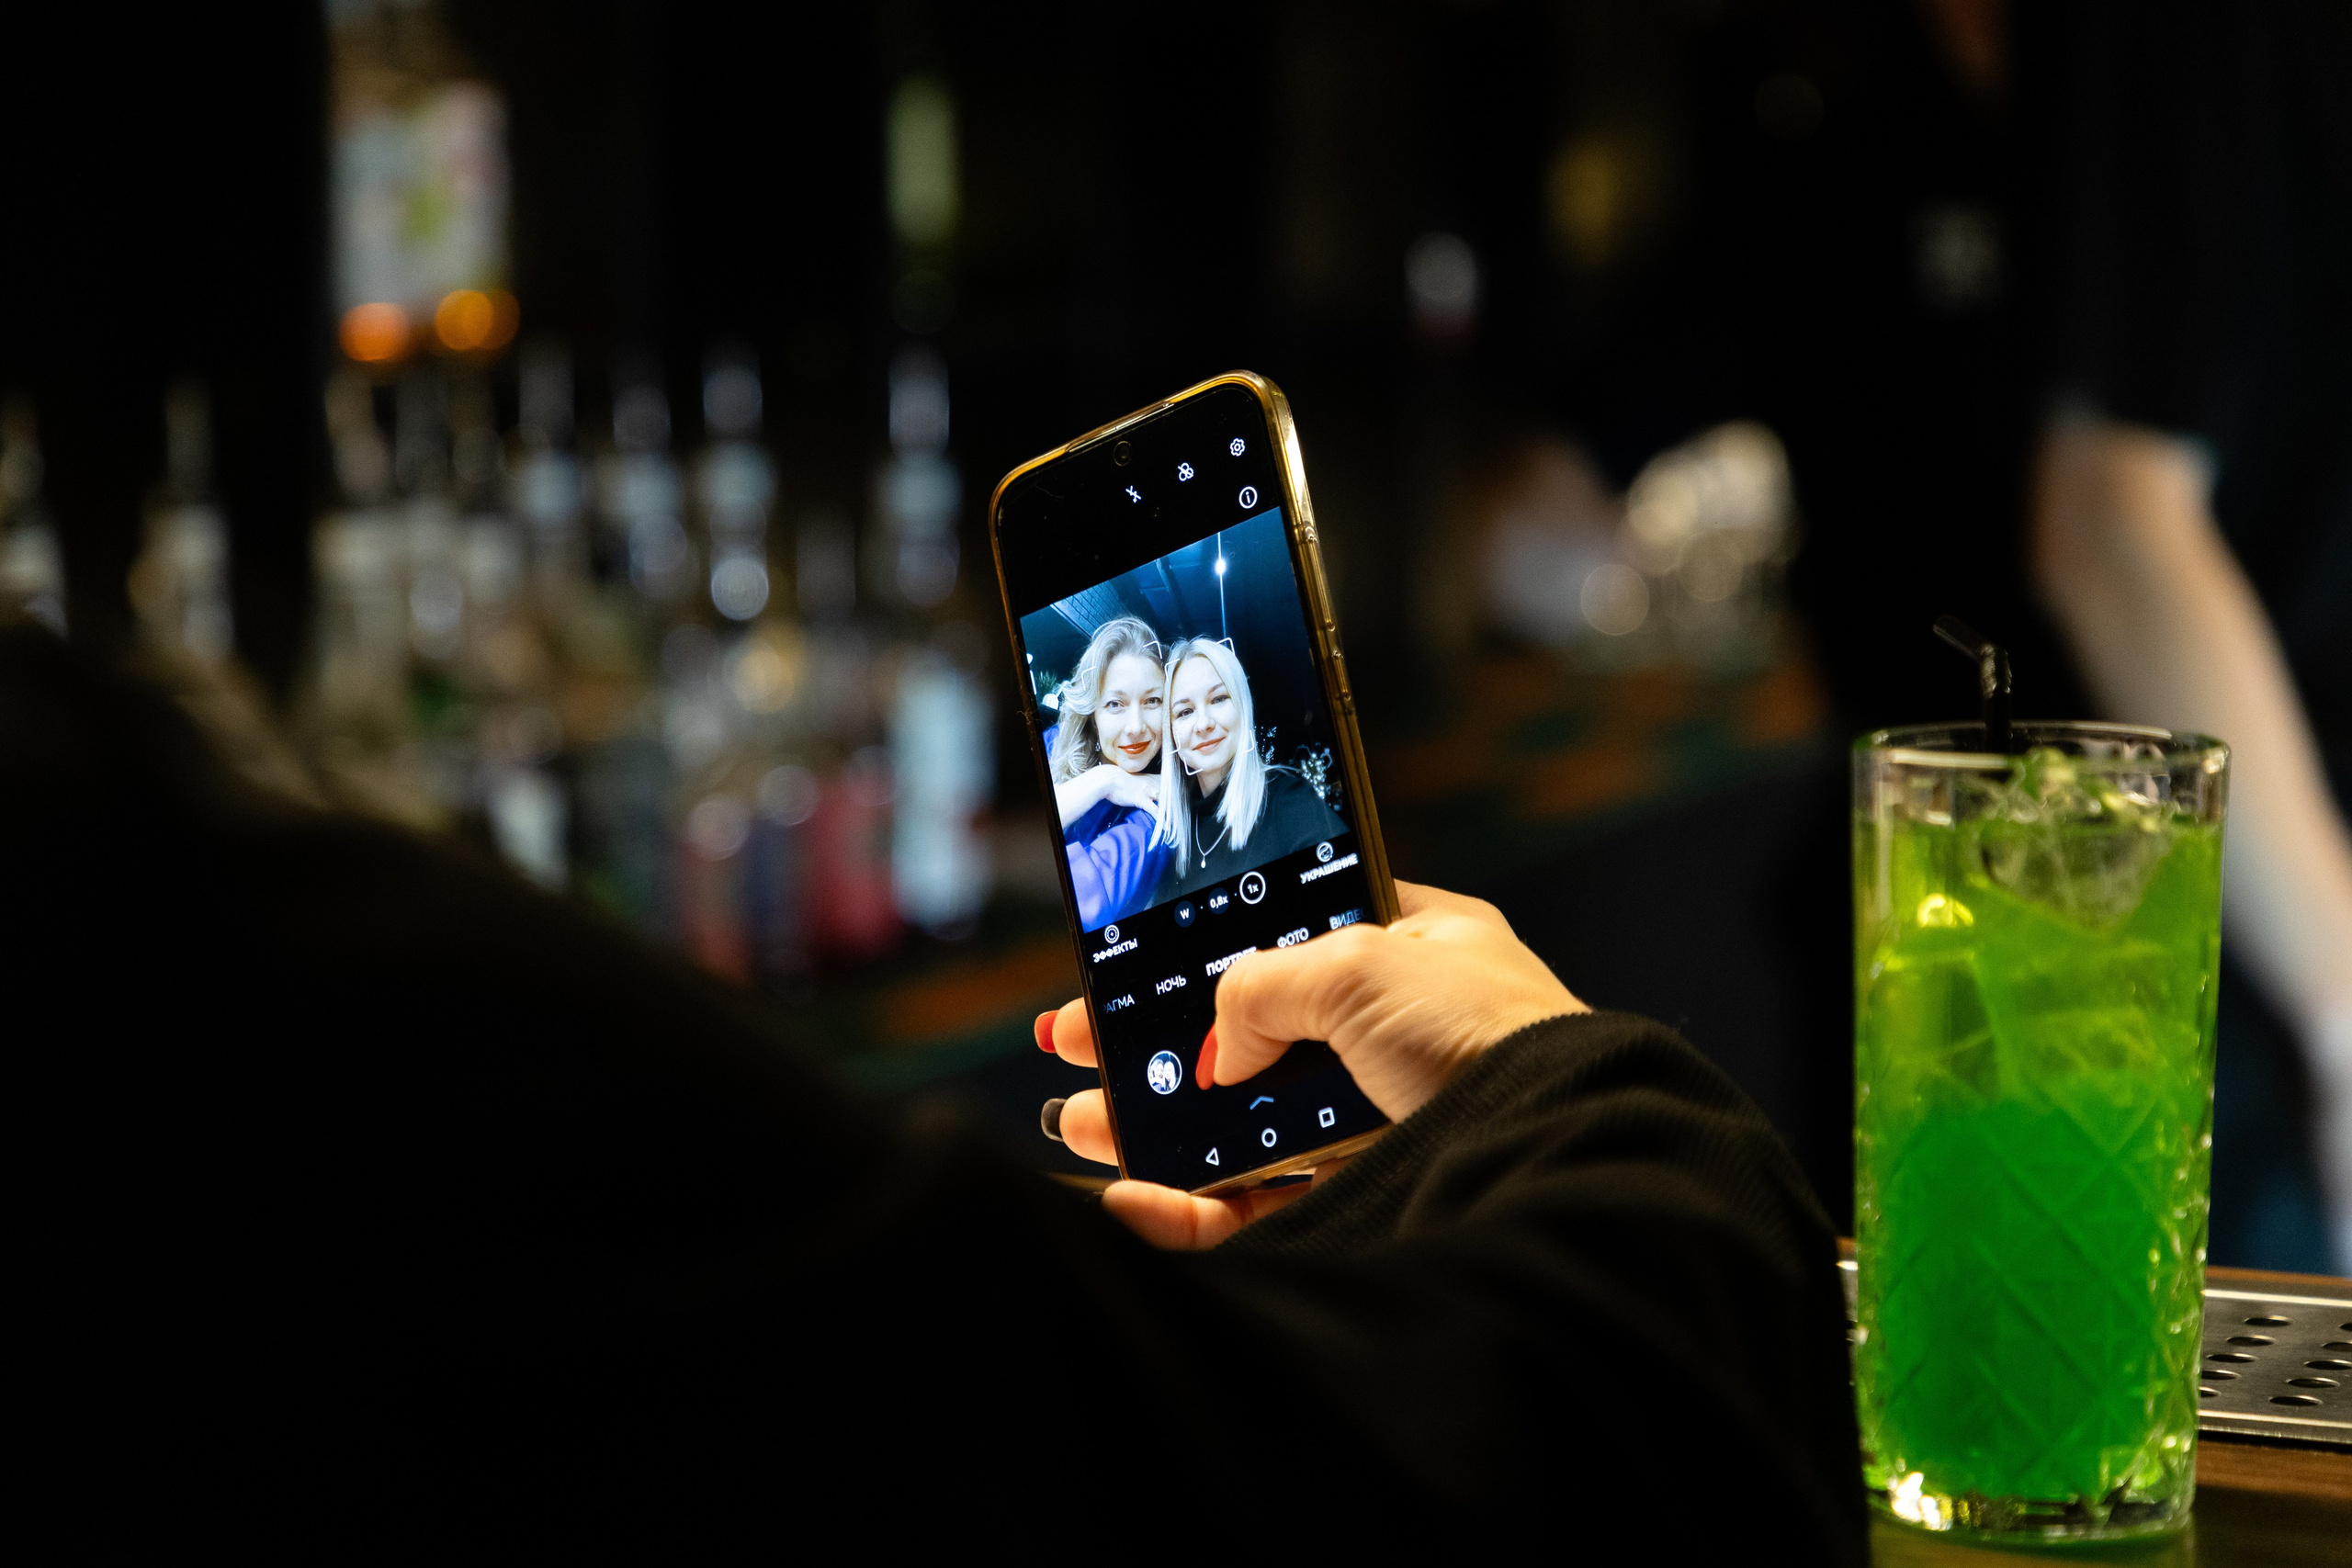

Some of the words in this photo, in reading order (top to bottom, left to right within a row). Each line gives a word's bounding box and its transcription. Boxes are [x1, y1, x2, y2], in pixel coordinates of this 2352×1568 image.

[1300, 853, 1358, 884] УКРАШЕНИЕ
[1180, 908, 1190, 919] W
[1247, 883, 1259, 894] 1x
[1092, 938, 1138, 963] ЭФФЕКТЫ
[1155, 975, 1187, 995] НОЧЬ
[1276, 927, 1309, 948] ФОТО
